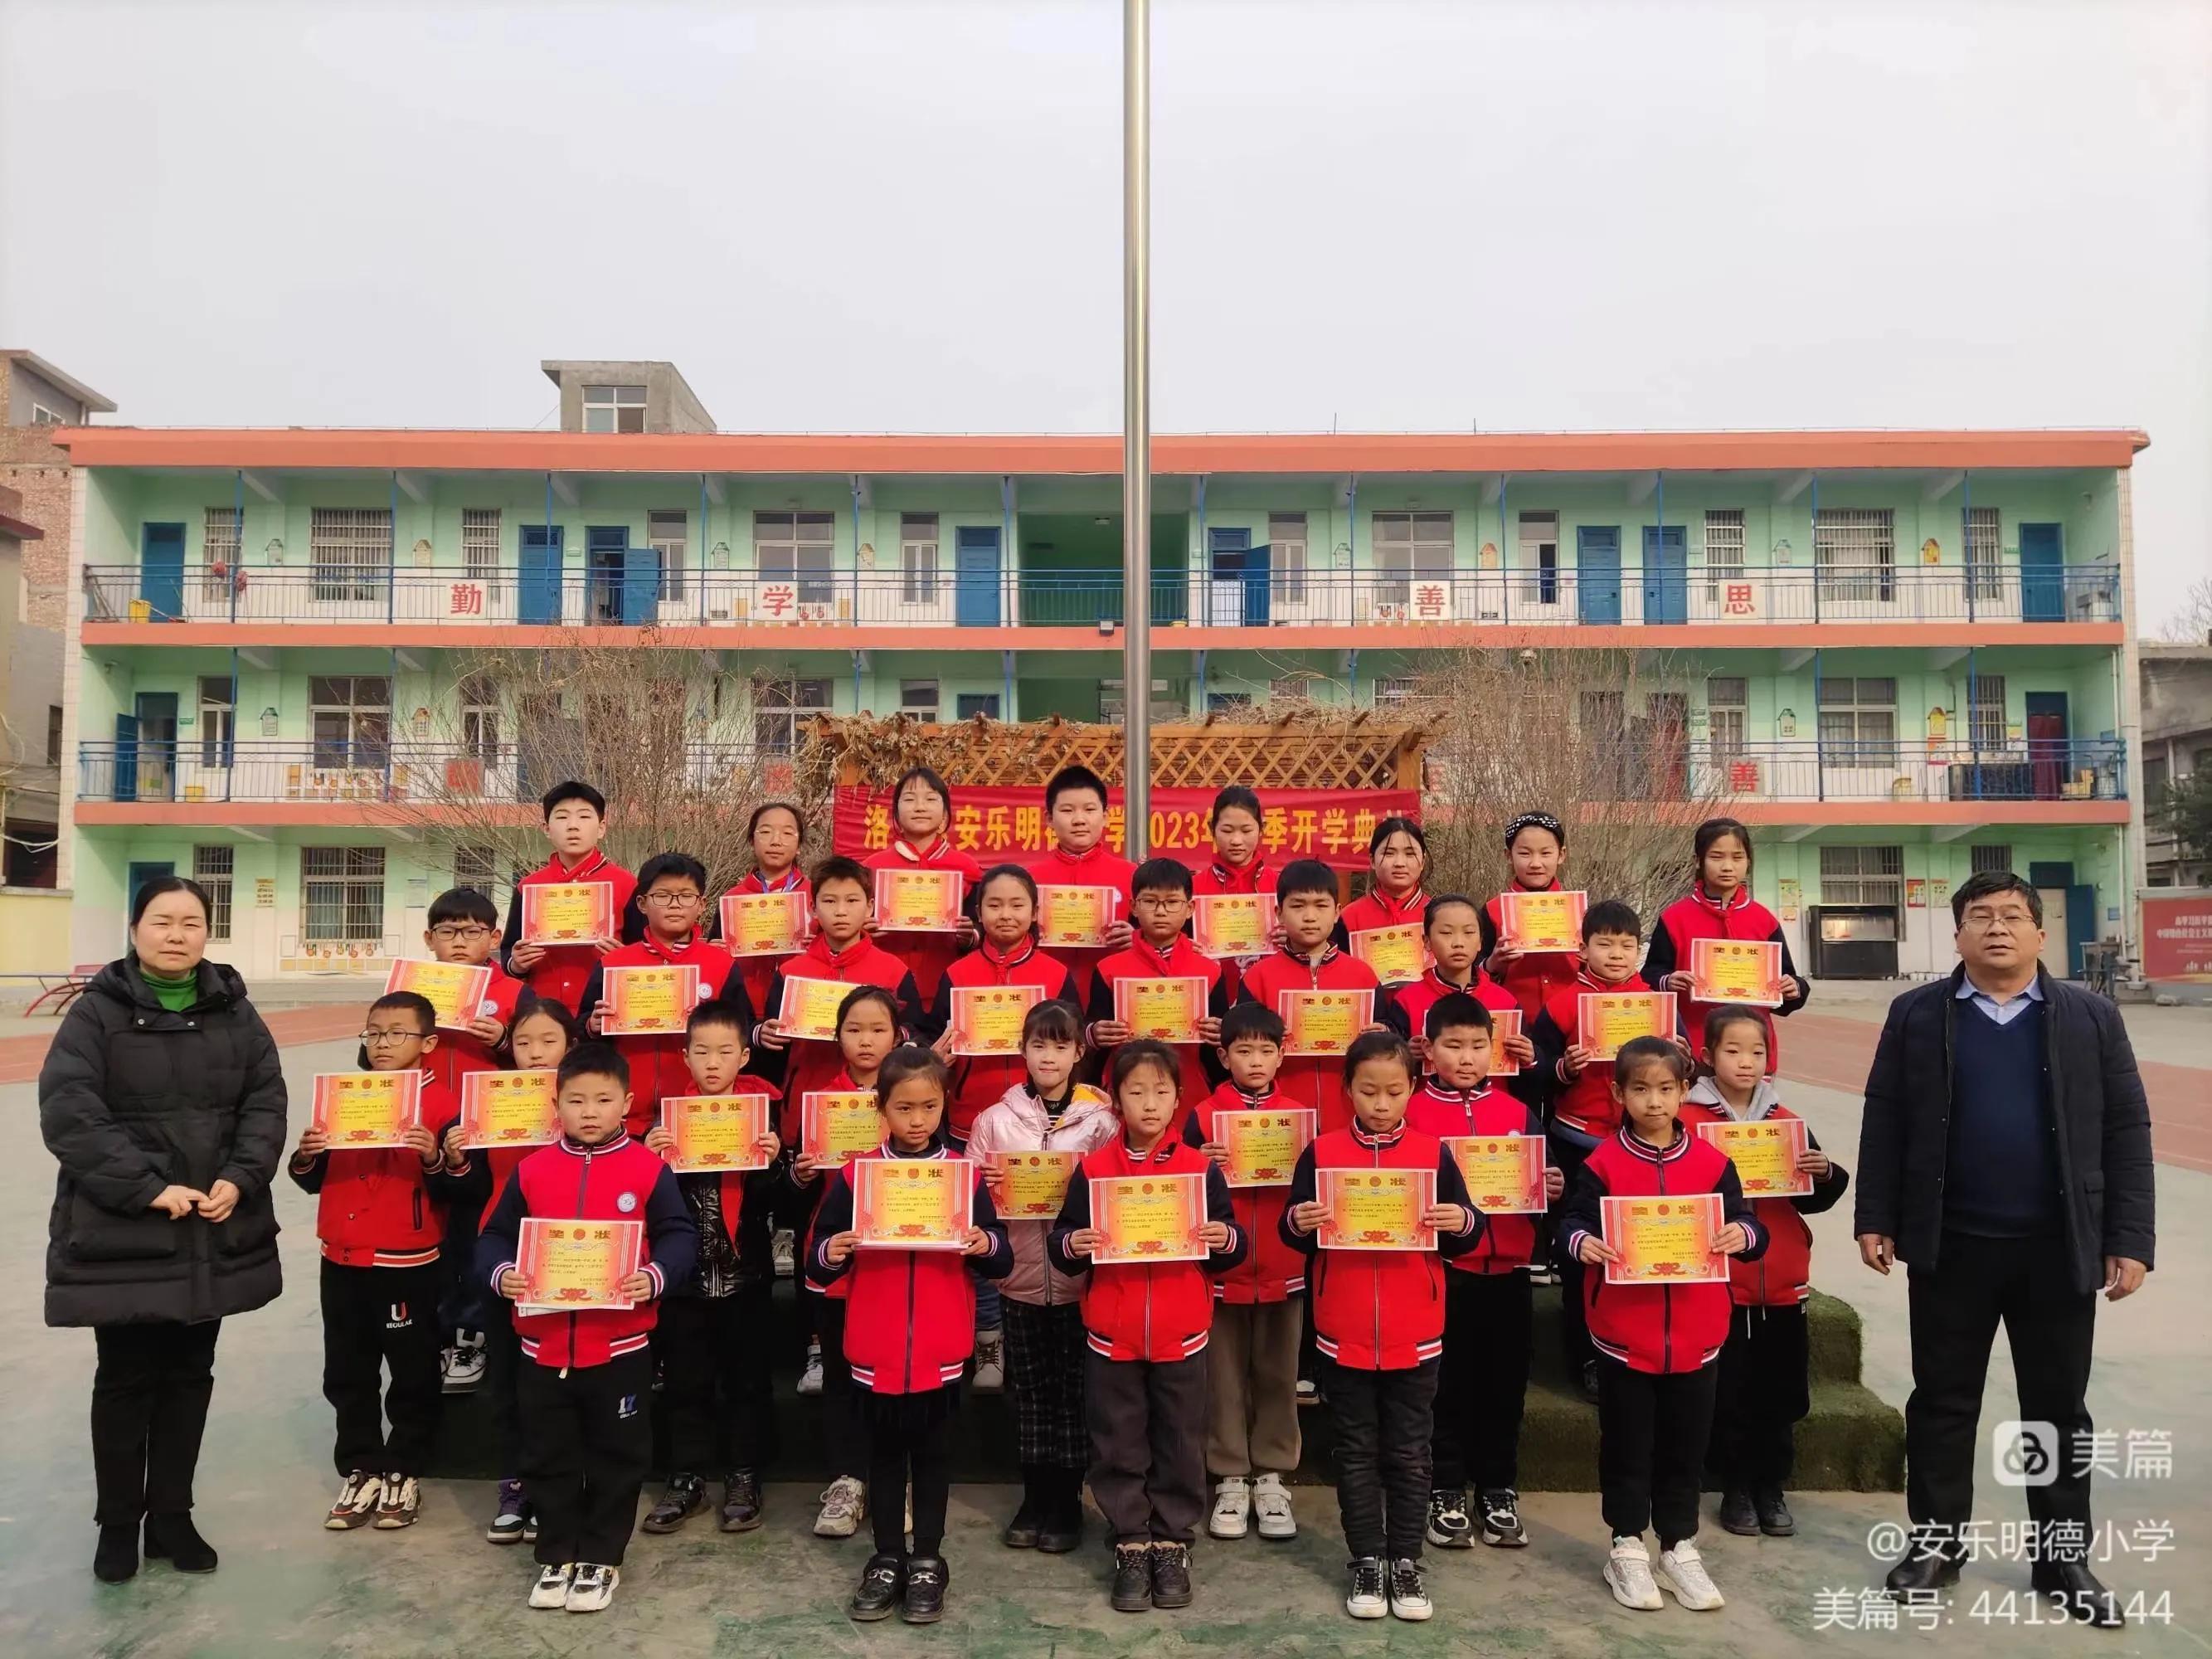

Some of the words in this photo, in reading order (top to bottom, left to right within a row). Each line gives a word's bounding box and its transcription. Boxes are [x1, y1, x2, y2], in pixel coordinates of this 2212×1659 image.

[450, 583, 482, 615] 勤
[762, 585, 794, 616] 学
[1414, 584, 1446, 616] 善
[1724, 583, 1756, 615] 思
